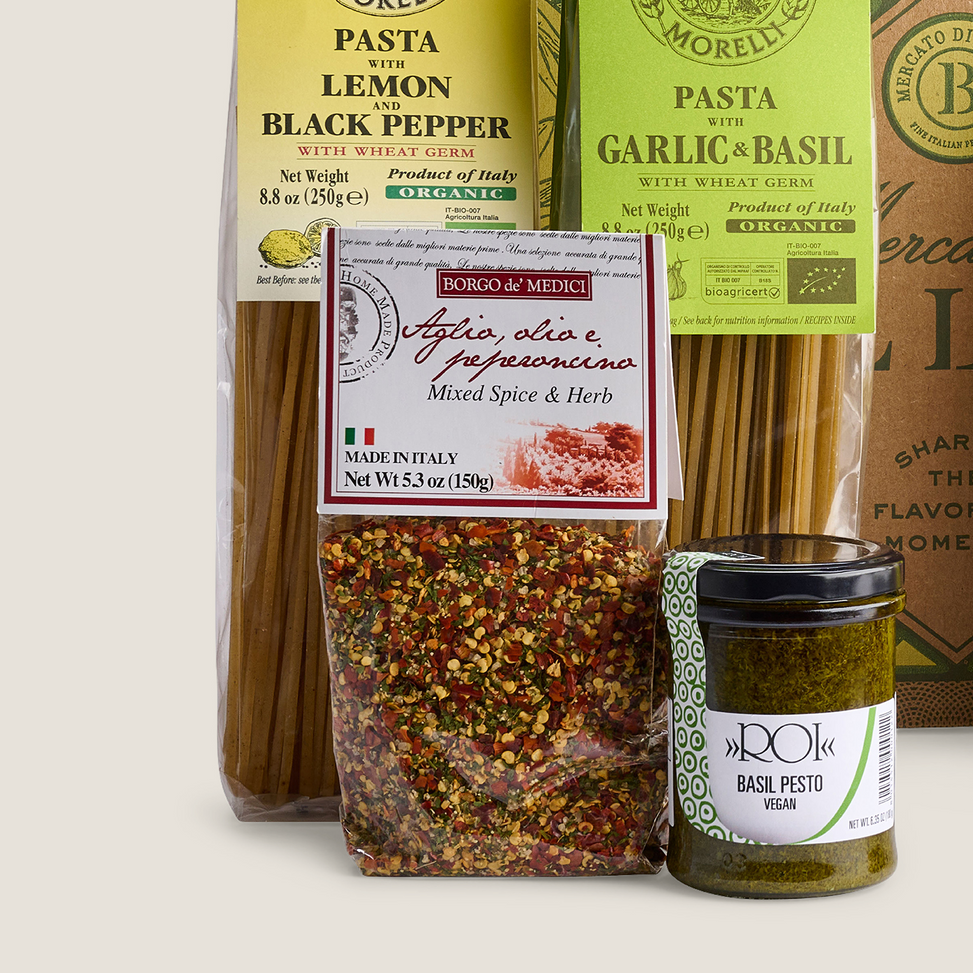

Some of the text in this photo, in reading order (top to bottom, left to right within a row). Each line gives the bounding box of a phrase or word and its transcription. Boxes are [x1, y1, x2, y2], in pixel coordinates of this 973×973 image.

[334, 28, 440, 53] PASTA
[663, 20, 787, 59] MORELLI
[368, 59, 405, 69] WITH
[897, 30, 946, 103] MERCATO
[952, 27, 971, 42] DI
[321, 74, 452, 99] LEMON
[372, 101, 401, 111] AND
[674, 85, 778, 110] PASTA
[261, 113, 511, 140] BLACK PEPPER
[707, 117, 744, 127] WITH
[910, 122, 928, 139] FINE
[928, 134, 963, 149] ITALIAN
[597, 134, 853, 165] GARLIC & BASIL
[638, 177, 814, 188] WITH WHEAT GERM
[399, 187, 502, 199] ORGANIC
[739, 221, 842, 232] ORGANIC
[443, 277, 500, 293] BORGO
[526, 280, 586, 293] MEDICI
[705, 286, 768, 297] bioagricert
[804, 315, 856, 325] RECIPES INSIDE
[402, 306, 505, 365] Aglio,
[514, 315, 574, 341] olio
[432, 344, 638, 382] peperoncino
[427, 384, 613, 406] Mixed Spice & Herb
[345, 451, 458, 465] MADE IN ITALY
[344, 471, 495, 492] Net Wt 5.3 oz (150g)
[737, 774, 823, 794] BASIL PESTO
[764, 797, 797, 811] VEGAN
